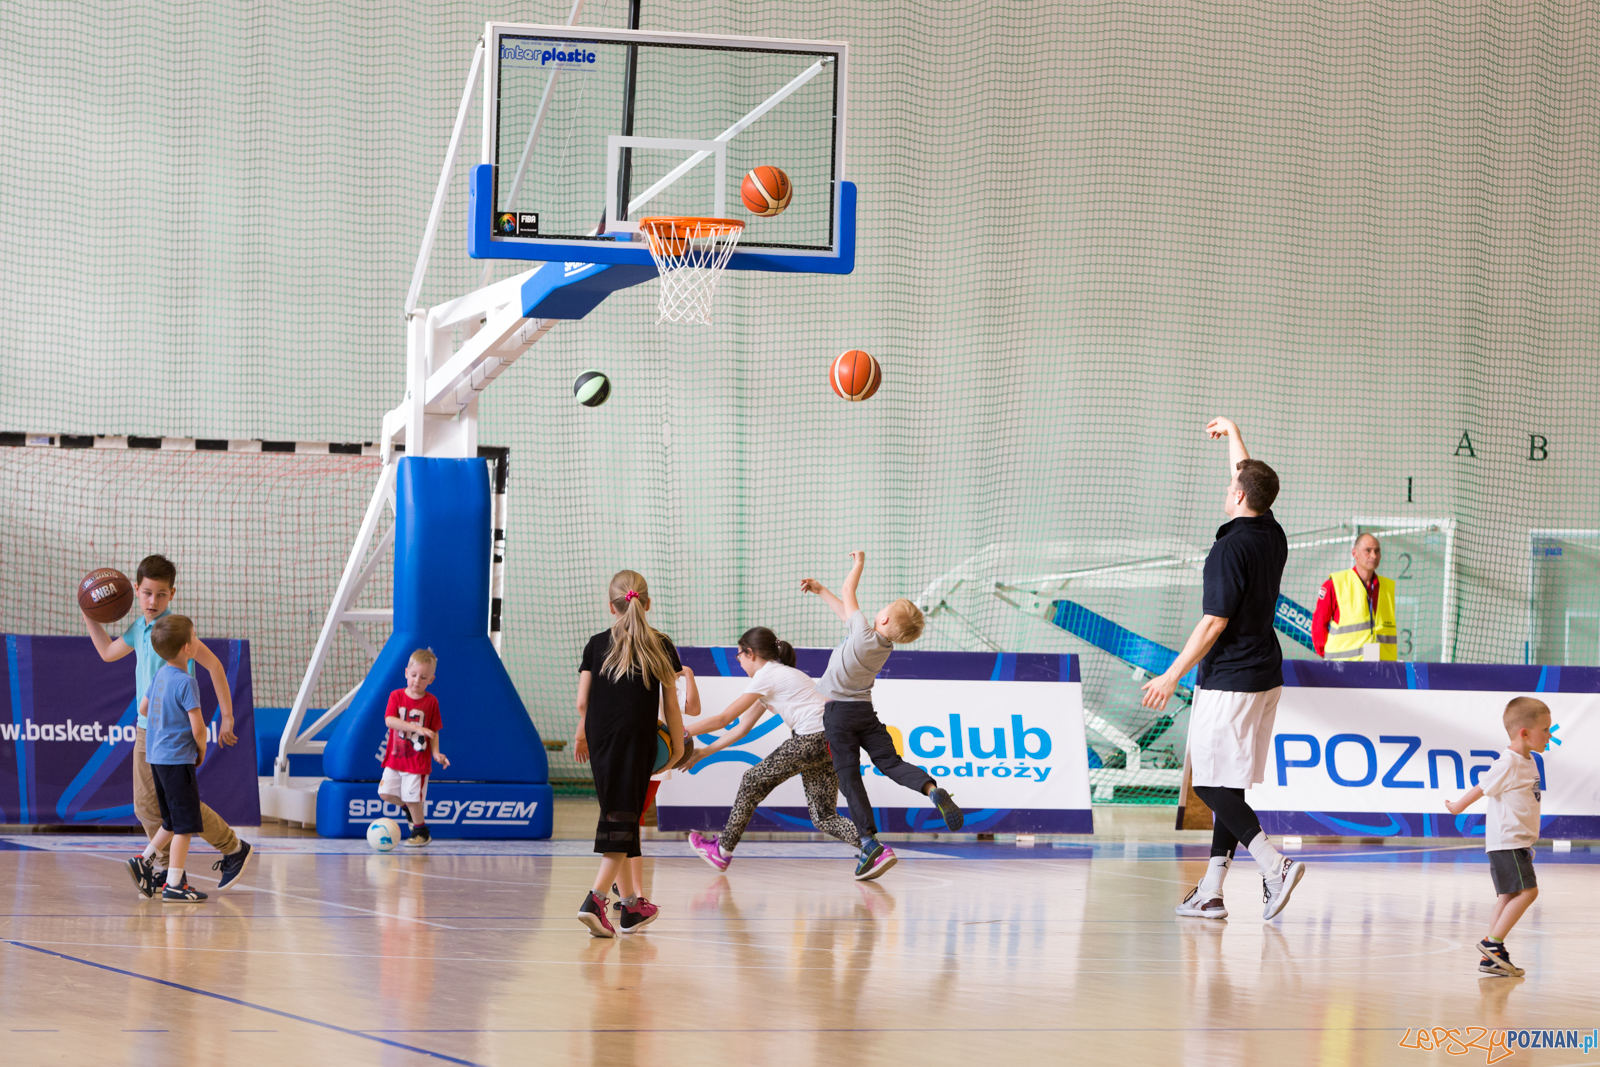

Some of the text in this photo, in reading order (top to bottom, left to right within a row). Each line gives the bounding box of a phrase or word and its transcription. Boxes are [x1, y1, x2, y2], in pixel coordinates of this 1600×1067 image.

[500, 44, 596, 66] interplastic
[520, 214, 537, 223] FIBA
[1453, 429, 1477, 457] A
[1527, 433, 1549, 461] B
[1397, 552, 1413, 579] 2
[95, 582, 118, 600] NBA
[1399, 628, 1413, 655] 3
[923, 762, 1053, 782] odróży
